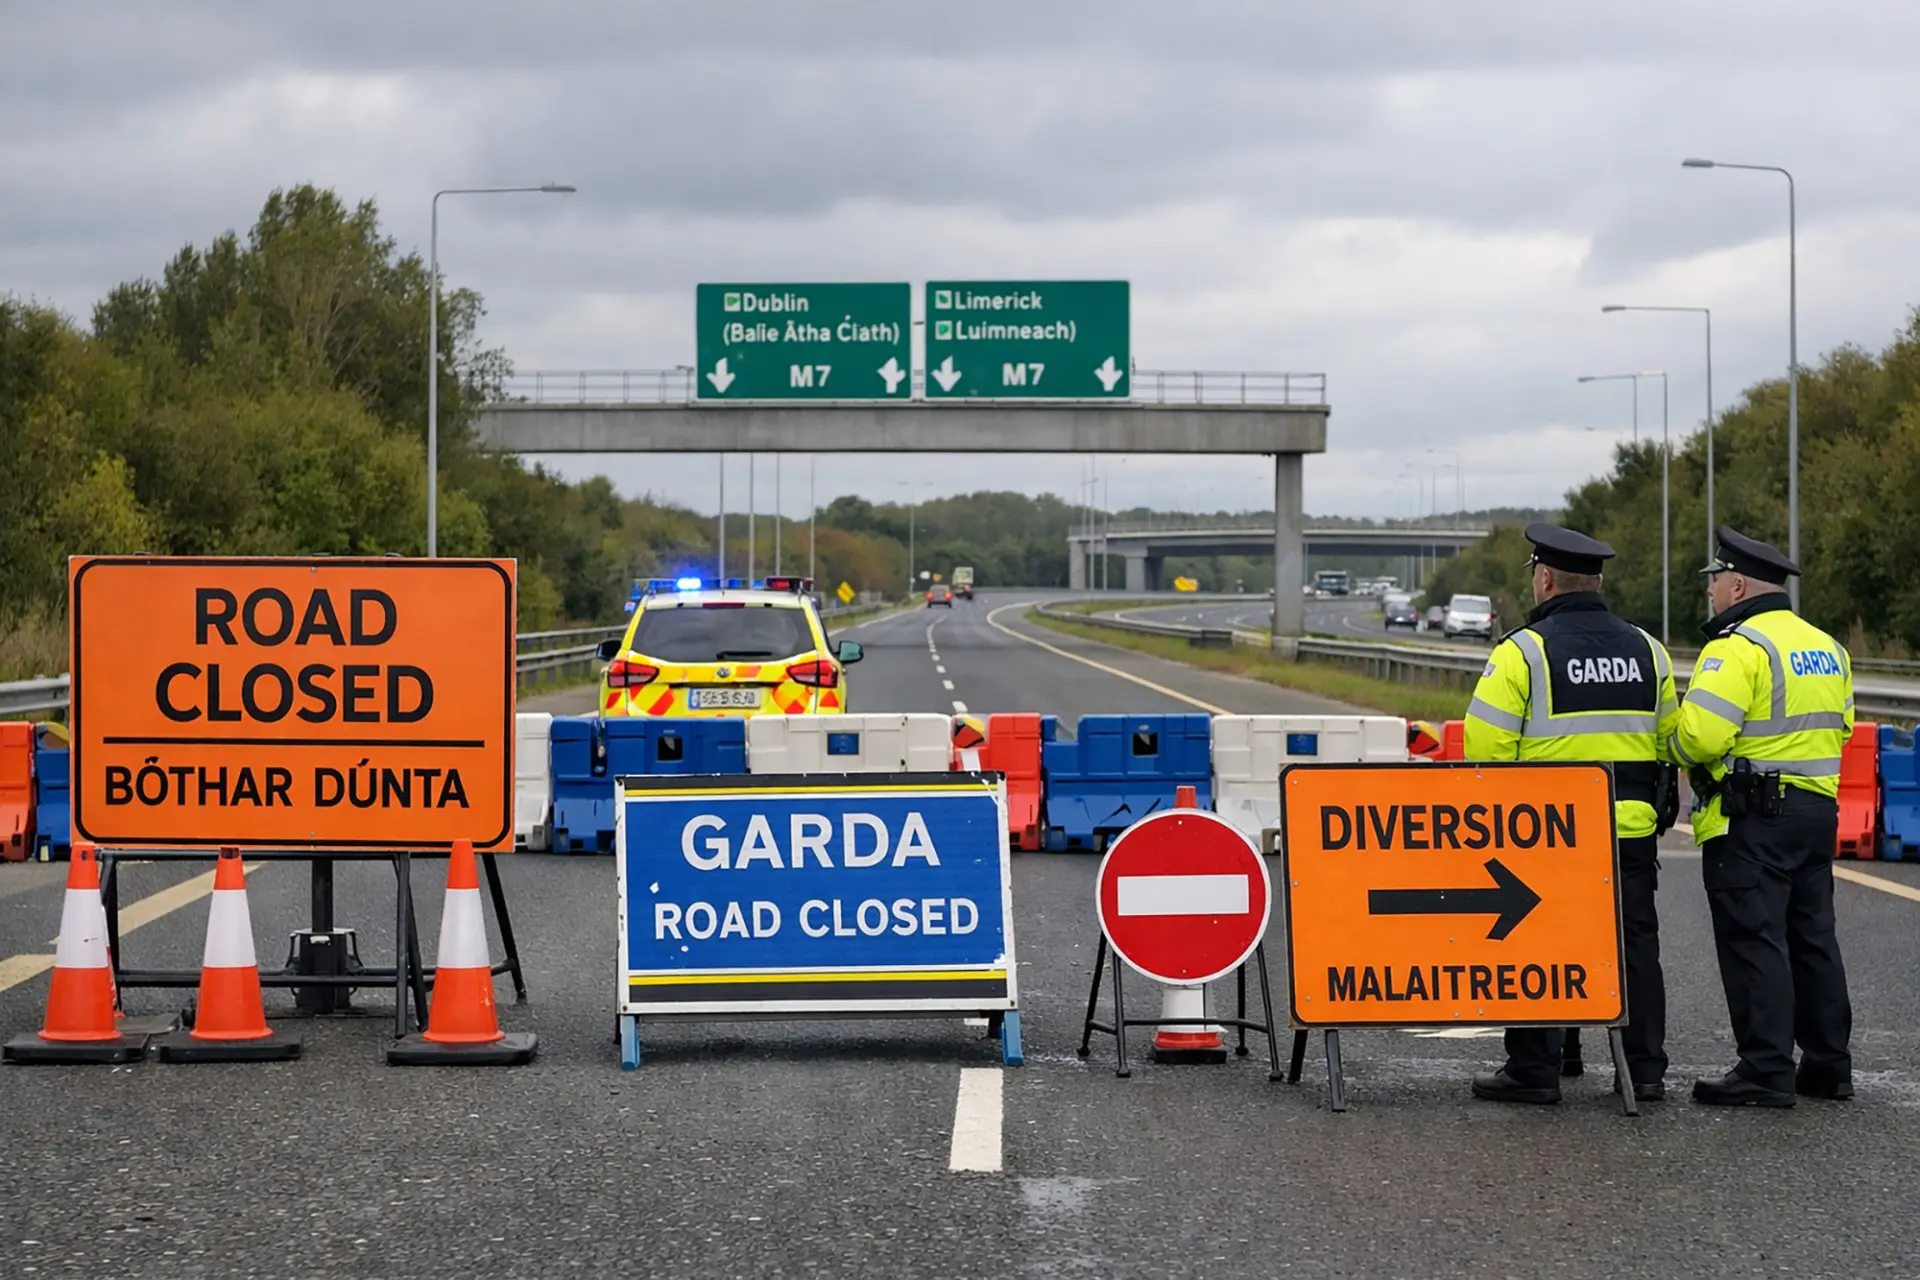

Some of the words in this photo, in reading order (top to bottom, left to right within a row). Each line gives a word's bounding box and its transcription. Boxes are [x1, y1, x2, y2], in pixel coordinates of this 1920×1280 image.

[743, 292, 809, 312] Dublin
[955, 291, 1043, 310] Limerick
[790, 364, 832, 388] M7
[1002, 362, 1045, 386] M7
[195, 587, 398, 647] ROAD
[1567, 657, 1643, 684] GARDA
[1789, 649, 1841, 677] GARDA
[155, 662, 434, 724] CLOSED
[314, 758, 470, 809] DÚNTA
[681, 812, 941, 871] GARDA
[1320, 803, 1576, 851] DIVERSION
[655, 900, 781, 940] ROAD
[799, 897, 979, 938] CLOSED
[1327, 963, 1588, 1002] MALAITREOIR
